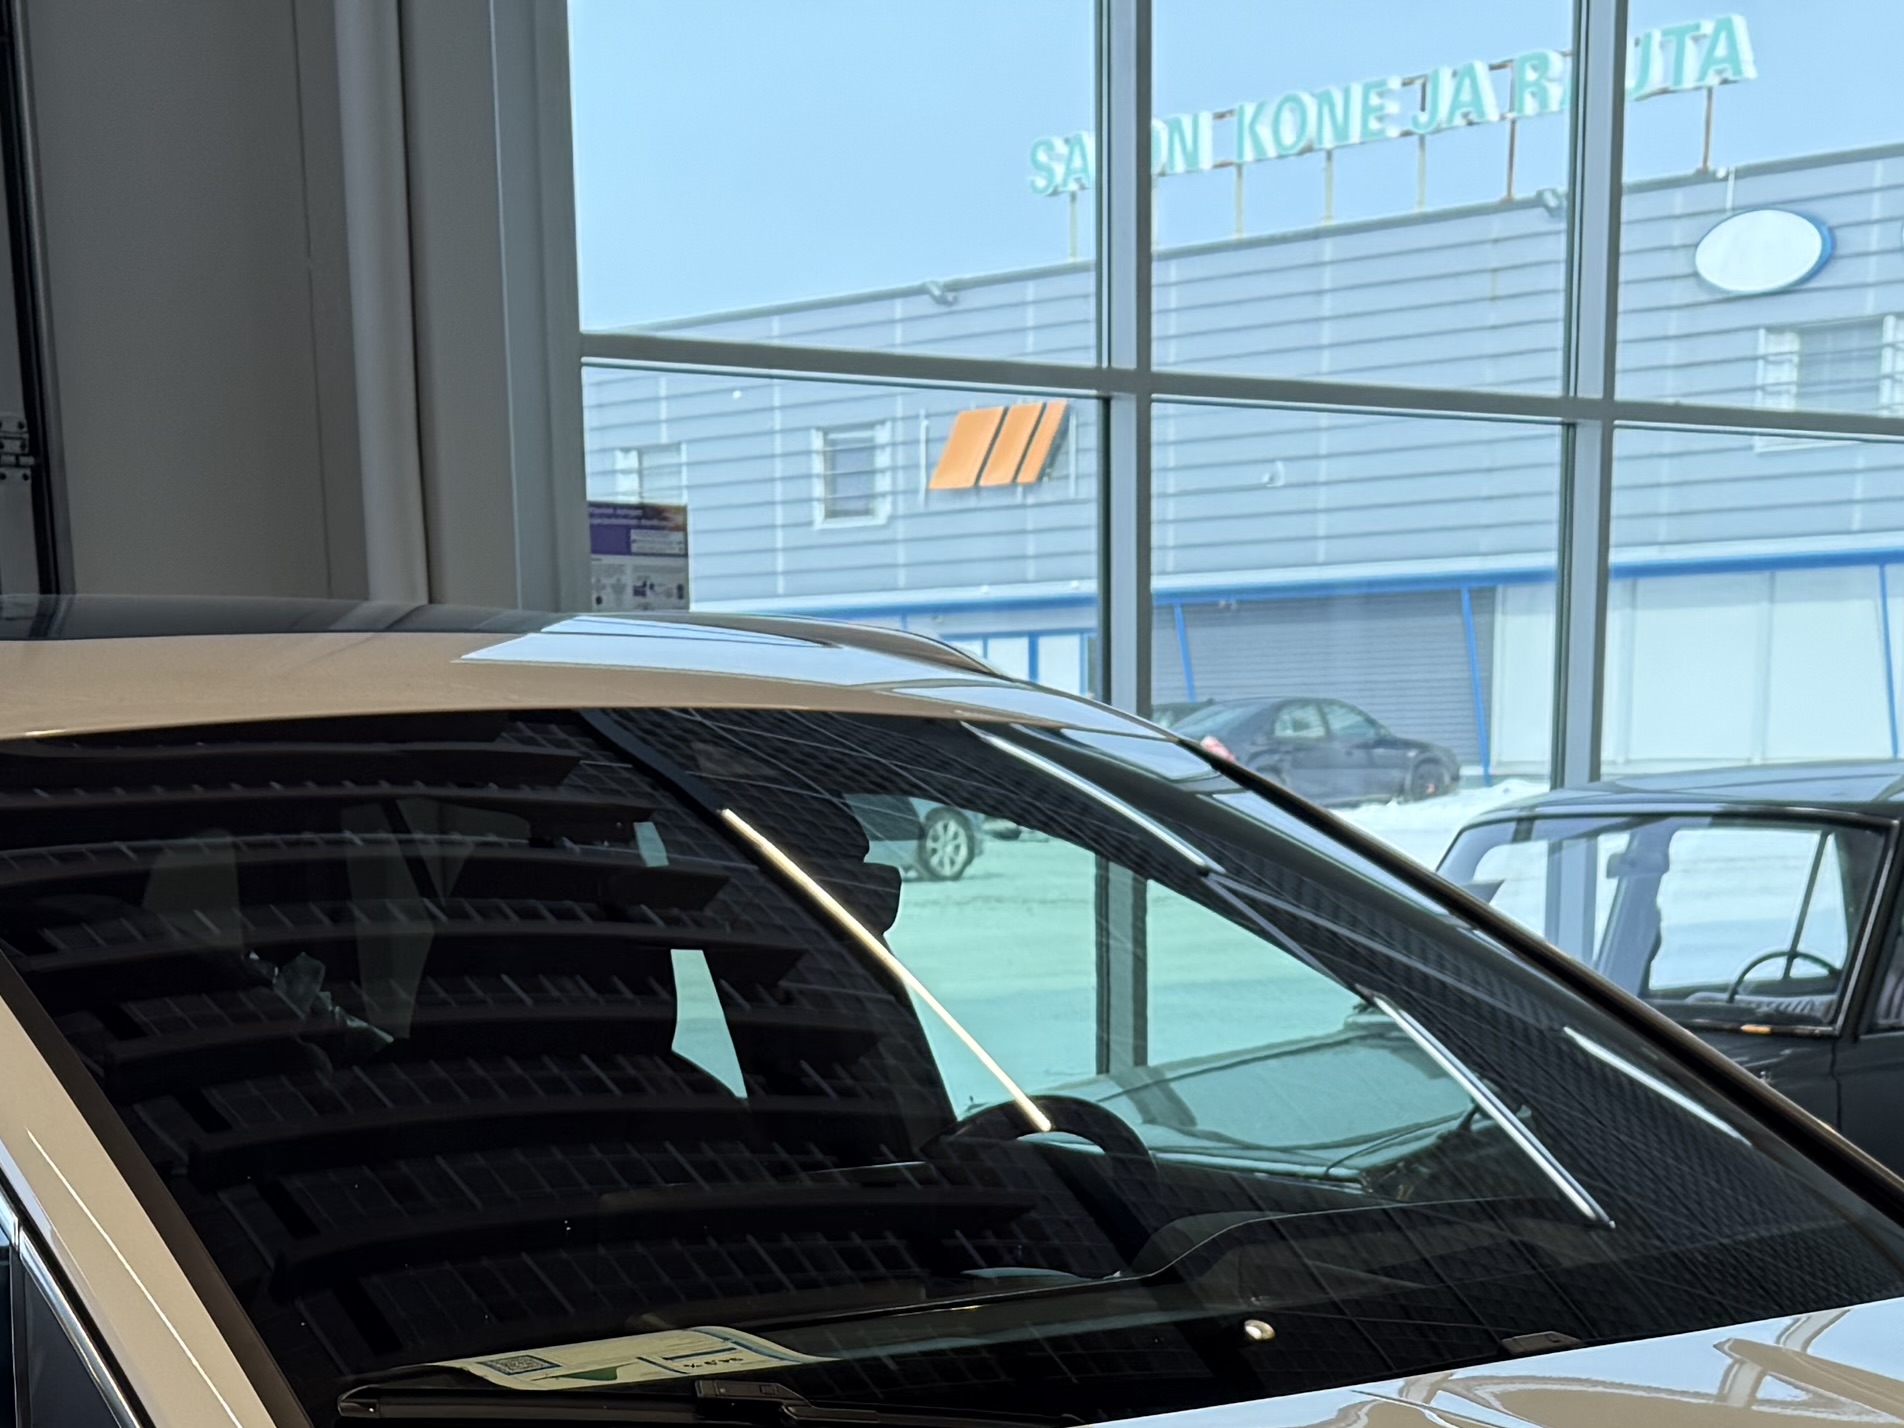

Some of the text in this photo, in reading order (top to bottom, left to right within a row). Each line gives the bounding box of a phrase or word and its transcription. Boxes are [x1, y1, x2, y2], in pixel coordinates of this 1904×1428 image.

[1028, 14, 1757, 195] SAN KONE JA RUTA
